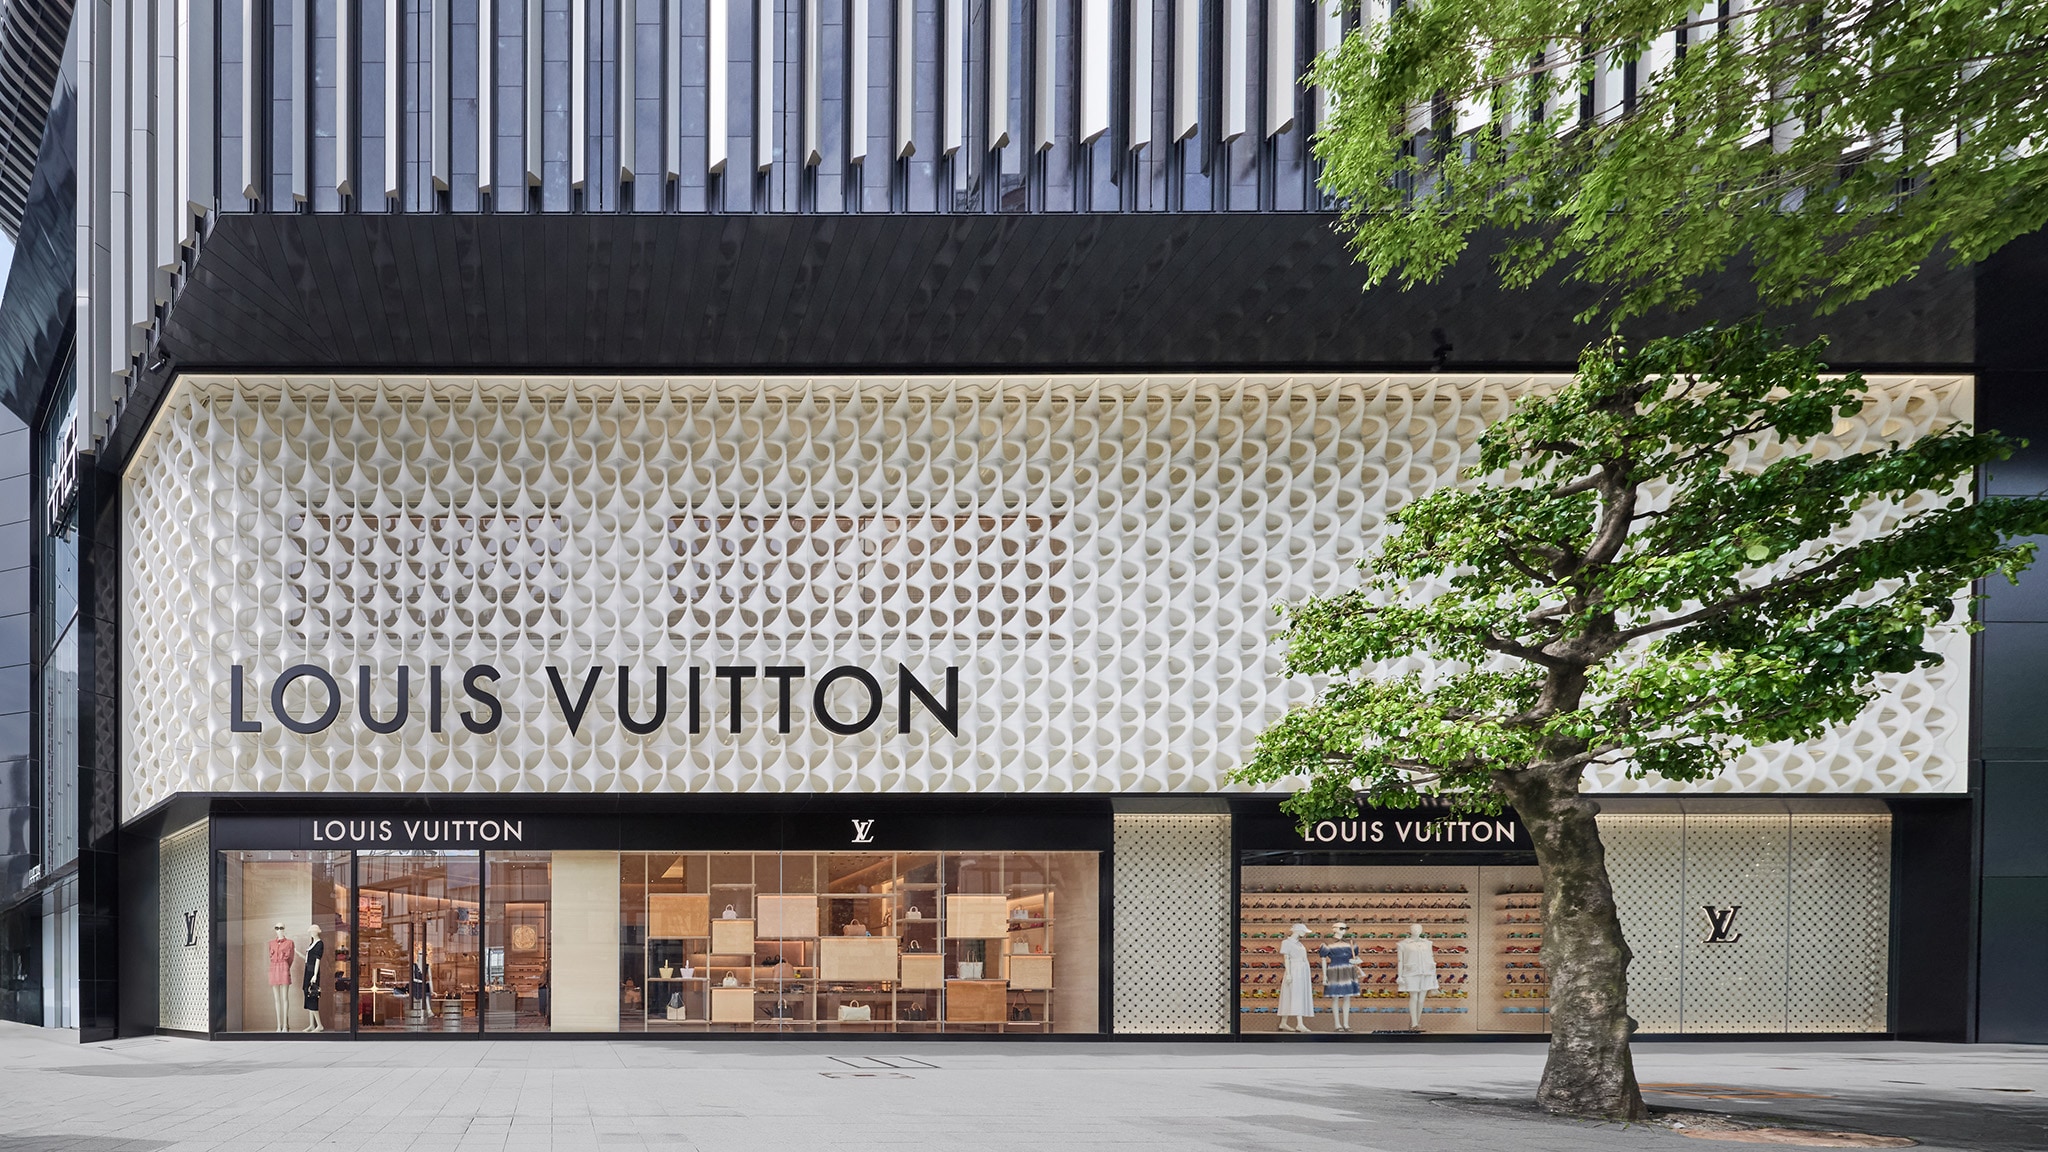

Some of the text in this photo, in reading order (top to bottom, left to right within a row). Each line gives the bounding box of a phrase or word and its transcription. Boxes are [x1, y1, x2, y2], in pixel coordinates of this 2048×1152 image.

[231, 663, 959, 738] LOUIS VUITTON
[313, 820, 523, 842] LOUIS VUITTON
[851, 819, 875, 843] LV
[1303, 820, 1515, 843] LOUIS VUITTON
[1700, 906, 1743, 943] LV
